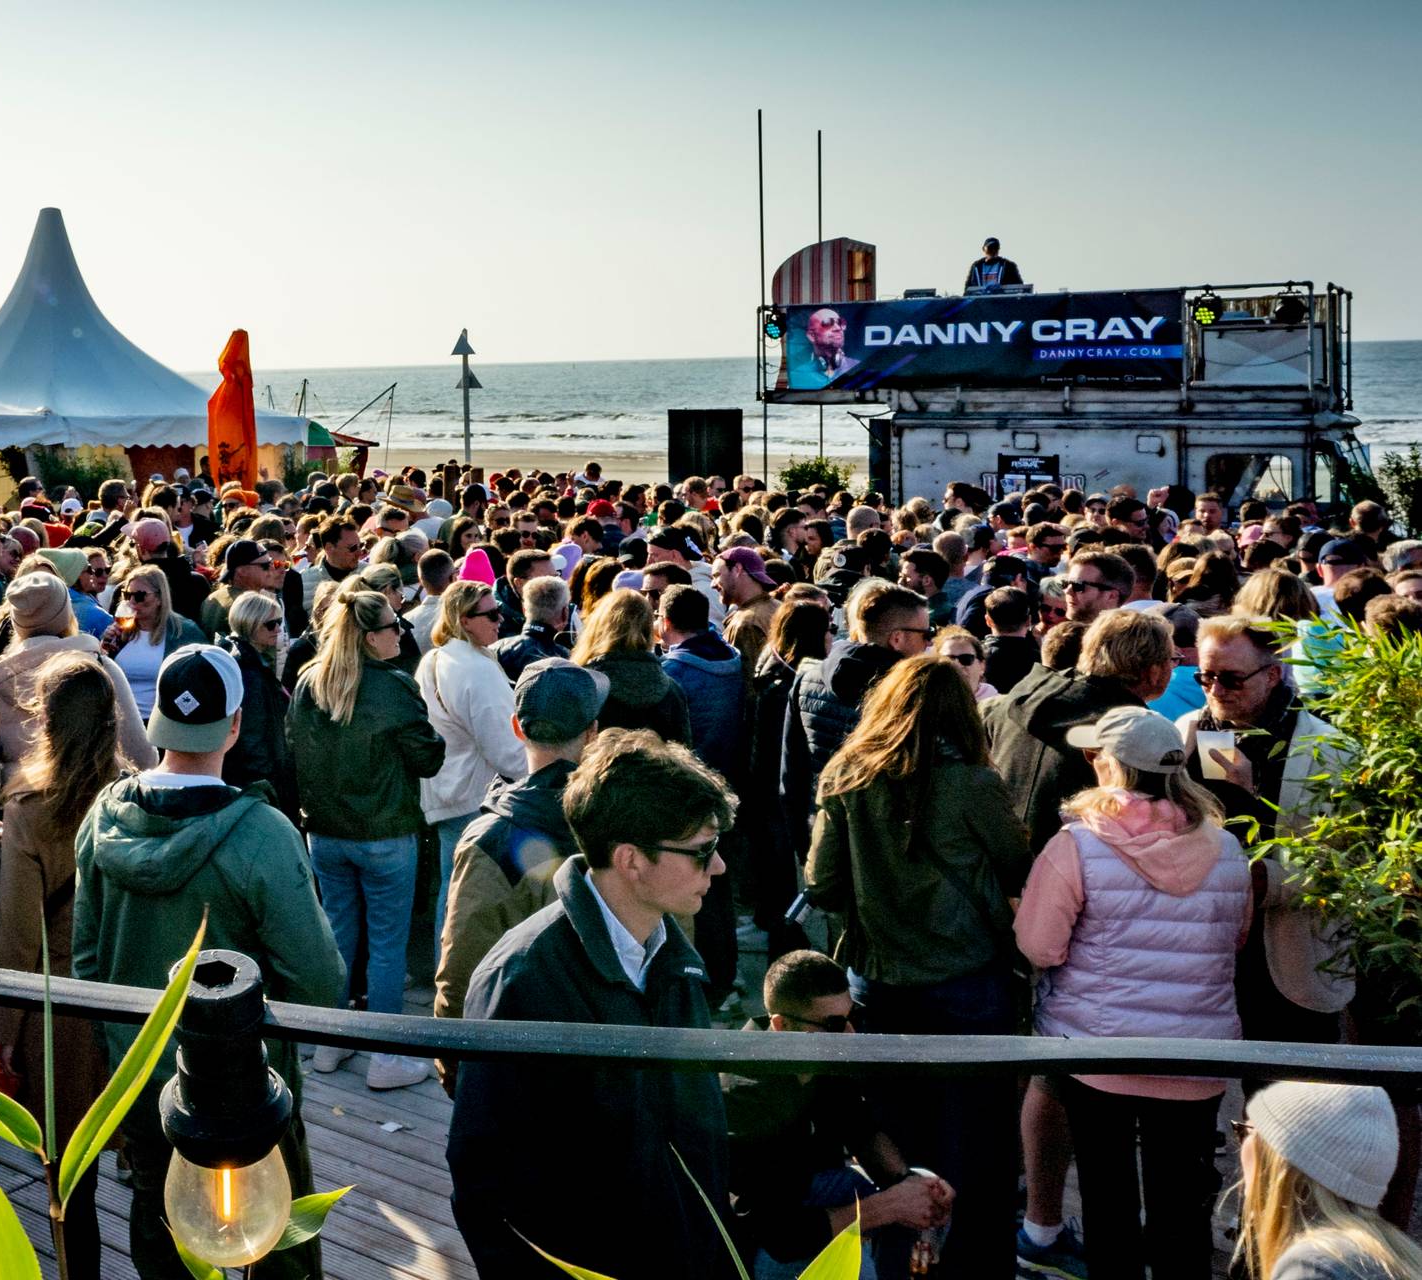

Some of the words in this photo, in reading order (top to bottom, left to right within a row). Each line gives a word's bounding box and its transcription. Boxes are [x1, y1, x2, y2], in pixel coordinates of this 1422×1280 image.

[864, 320, 1023, 347] DANNY
[1031, 316, 1165, 342] CRAY
[1039, 347, 1162, 359] DANNYCRAY.COM
